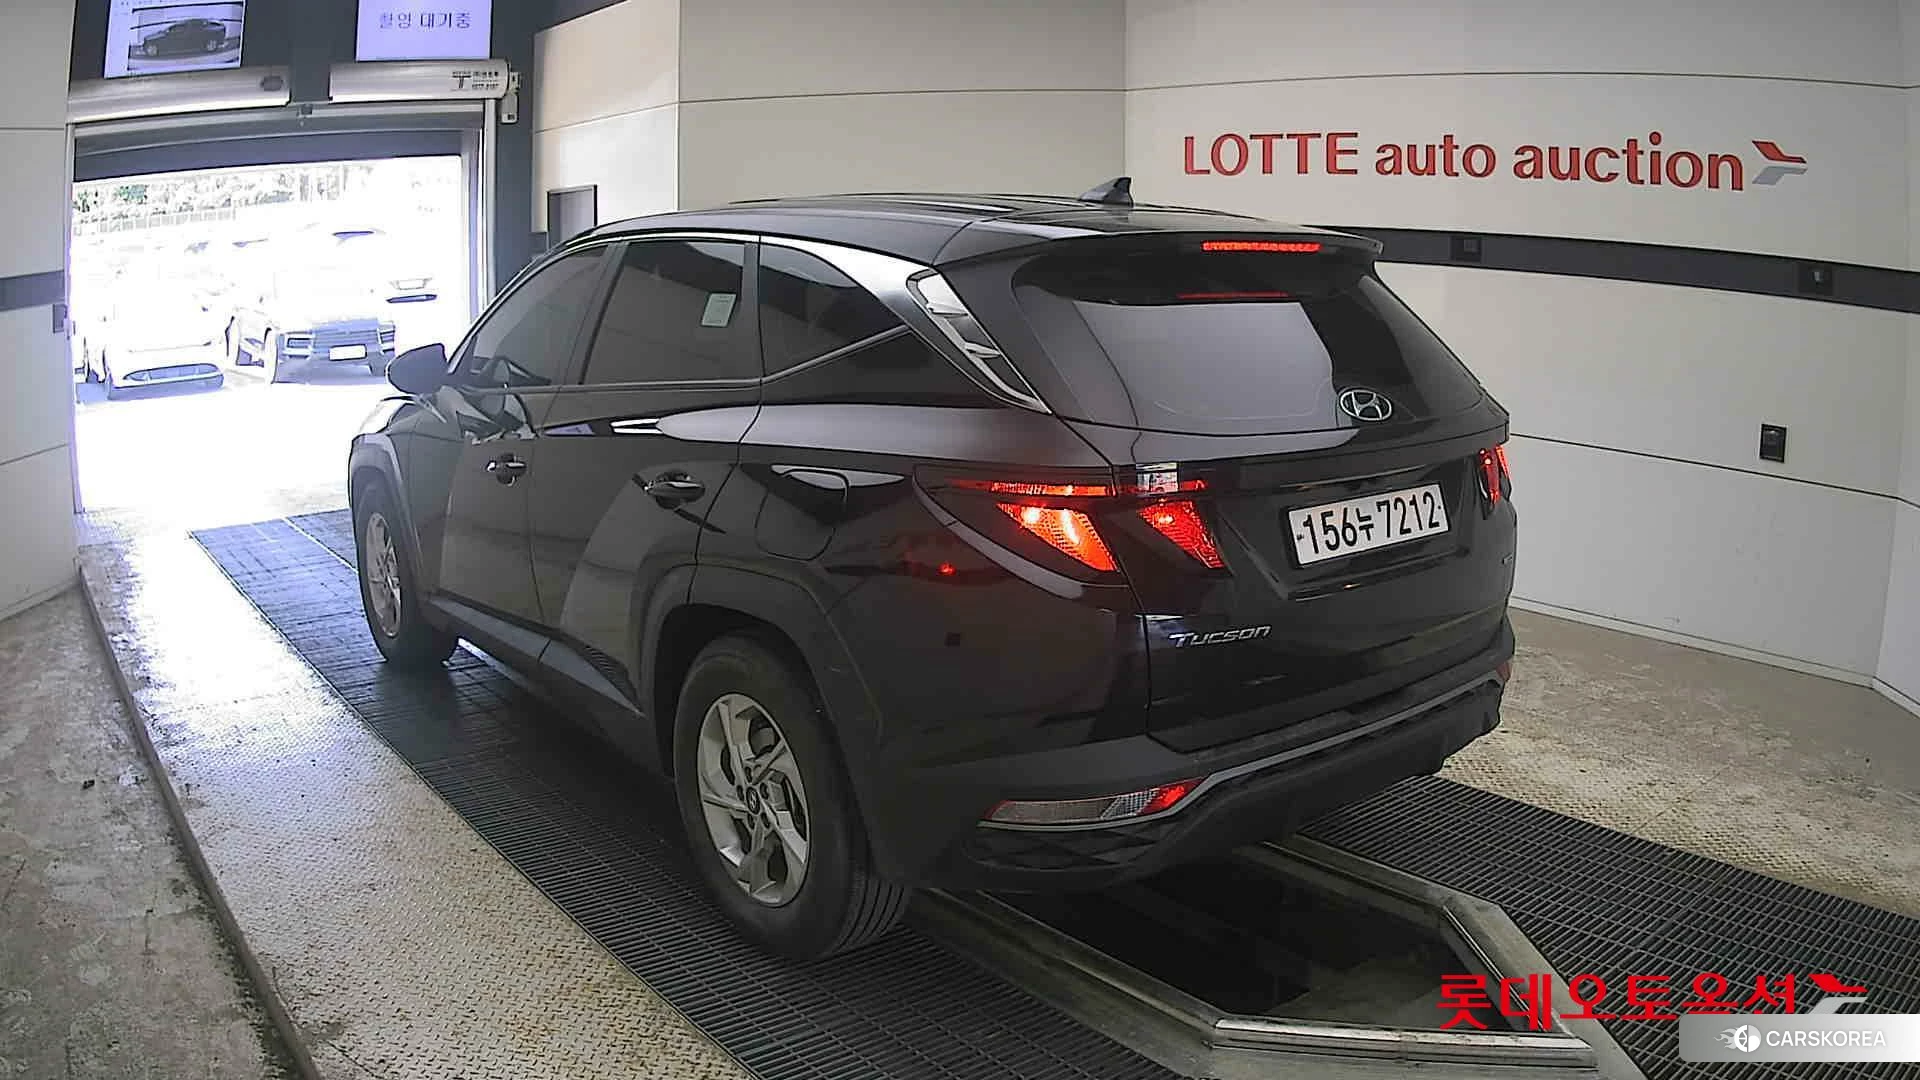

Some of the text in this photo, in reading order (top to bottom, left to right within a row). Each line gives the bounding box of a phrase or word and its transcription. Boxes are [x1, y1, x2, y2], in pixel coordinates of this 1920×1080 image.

[420, 12, 471, 29] 대기중
[1183, 131, 1744, 191] LOTTE auto auction
